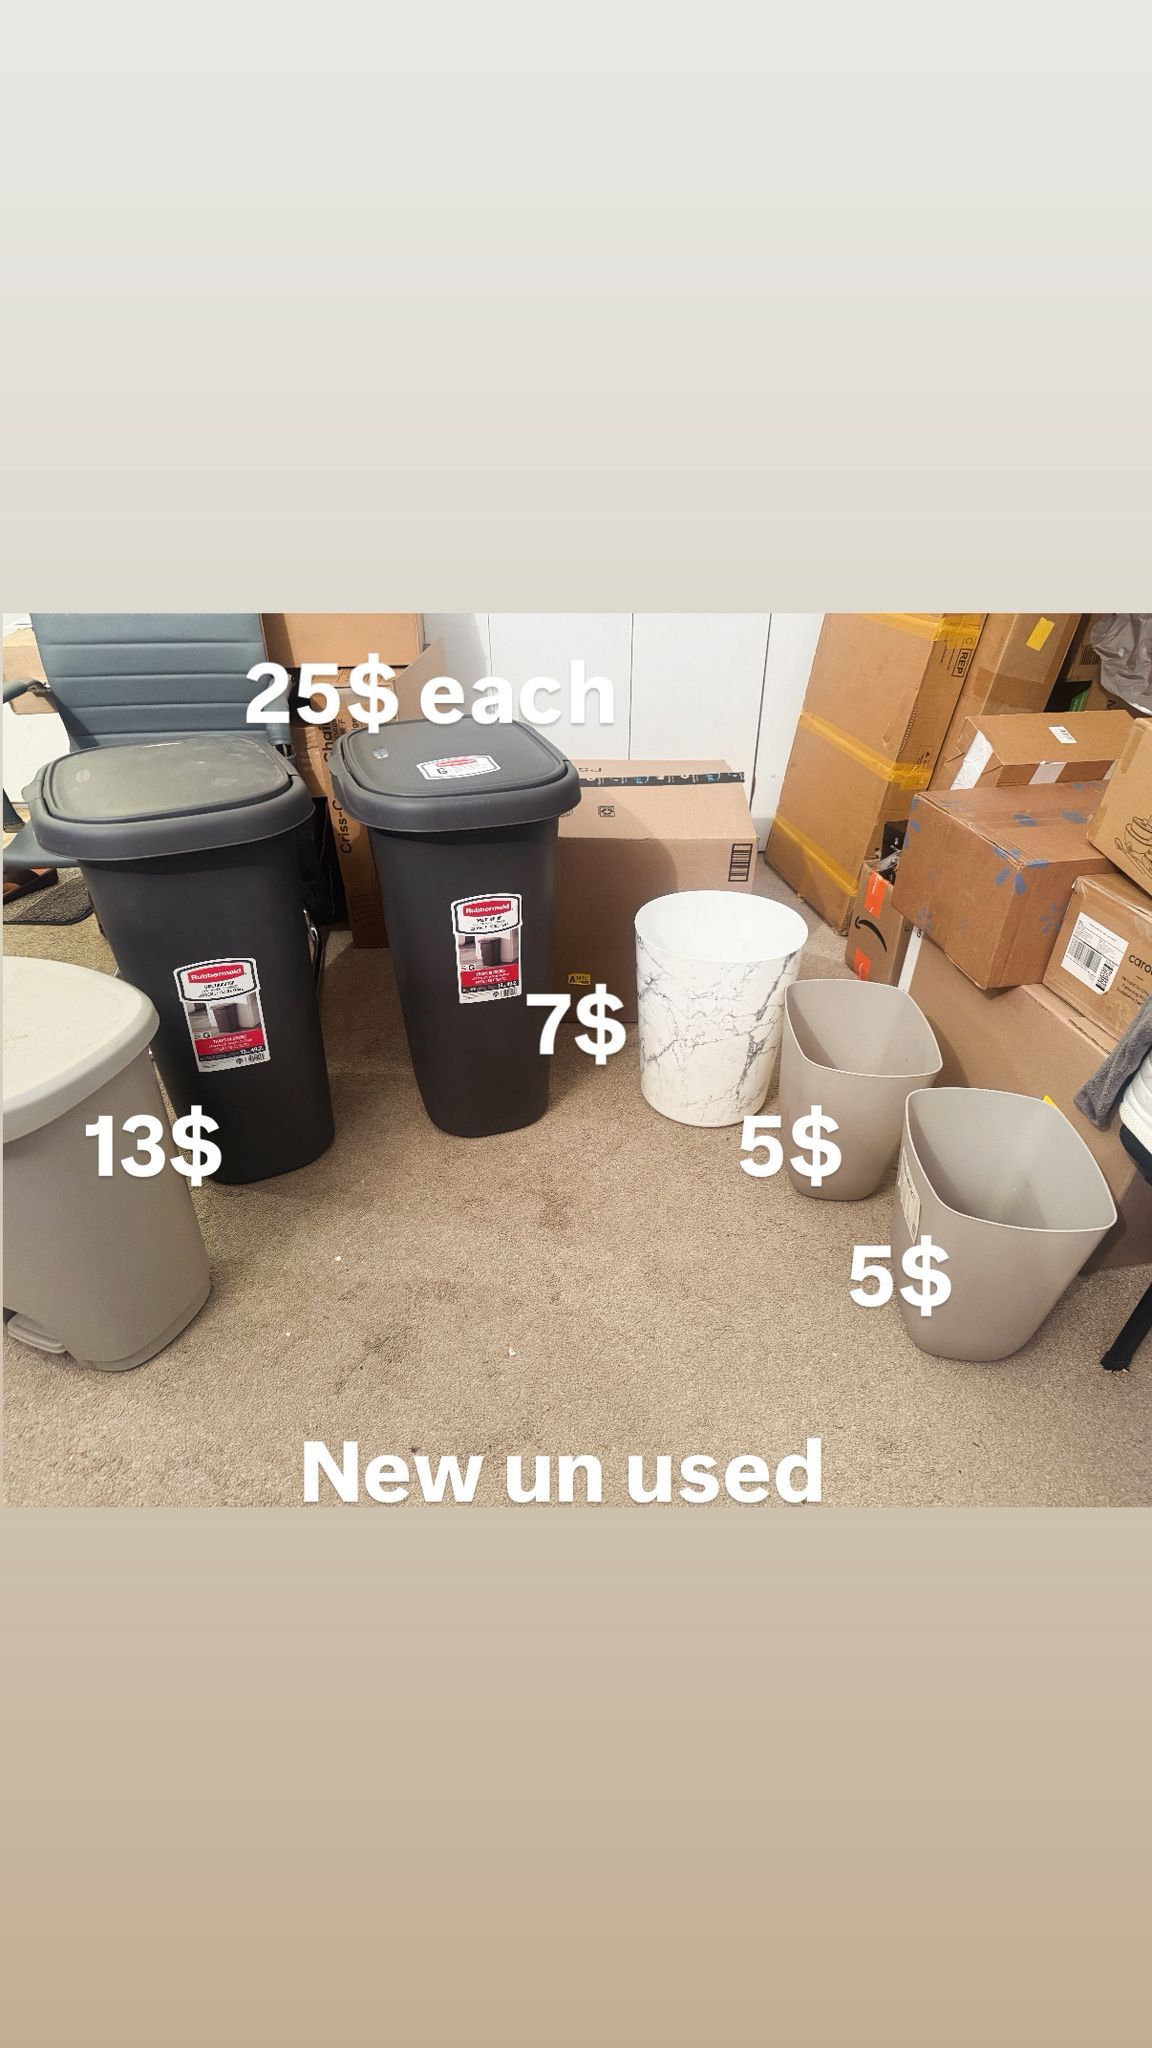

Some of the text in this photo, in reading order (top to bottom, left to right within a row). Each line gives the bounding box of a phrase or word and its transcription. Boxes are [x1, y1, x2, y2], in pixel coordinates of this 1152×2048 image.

[956, 651, 969, 674] REP
[331, 795, 352, 853] Criss-C
[465, 903, 510, 914] Rubbermaid
[190, 967, 242, 981] Rubbermaid
[1128, 954, 1152, 976] caro
